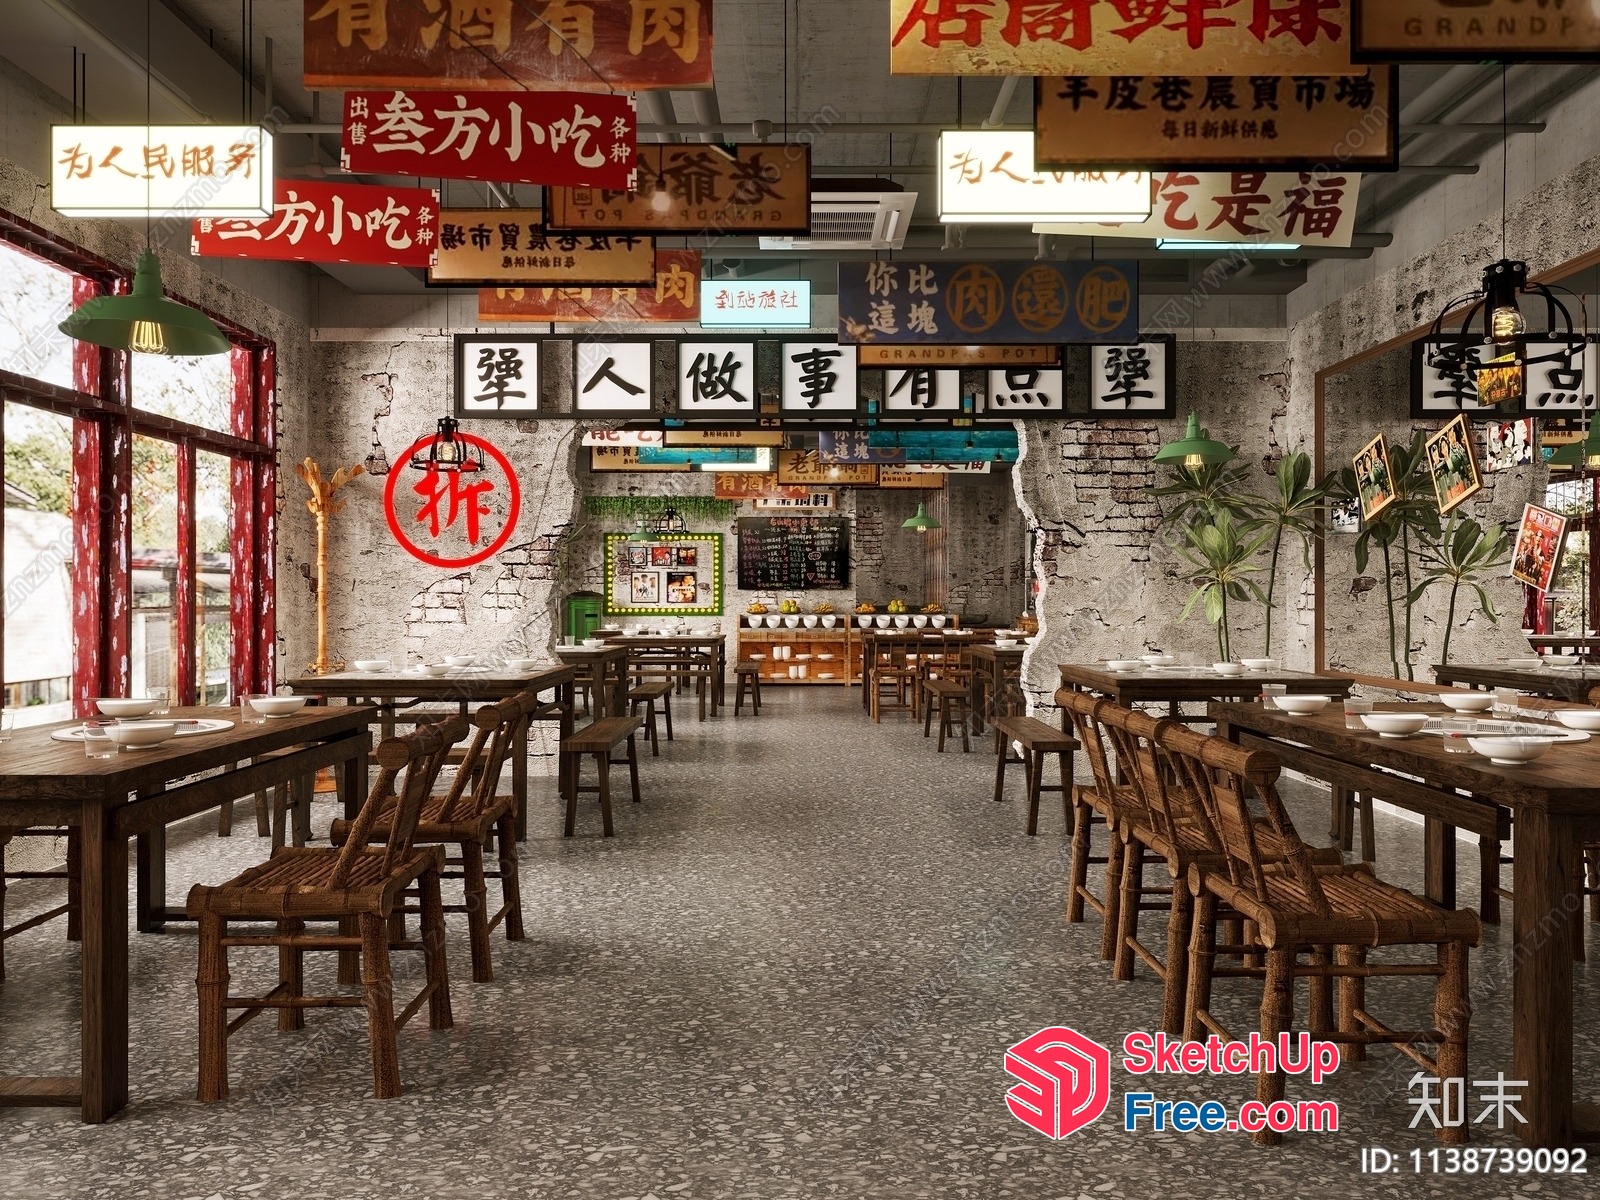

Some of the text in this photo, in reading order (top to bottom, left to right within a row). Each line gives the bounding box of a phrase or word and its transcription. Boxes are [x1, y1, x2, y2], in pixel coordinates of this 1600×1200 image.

[347, 96, 369, 146] 出售
[369, 90, 606, 168] 叁方小吃
[609, 116, 632, 164] 各种
[58, 142, 257, 180] 为人民服务
[415, 206, 435, 246] 各种
[1003, 348, 1038, 358] POT
